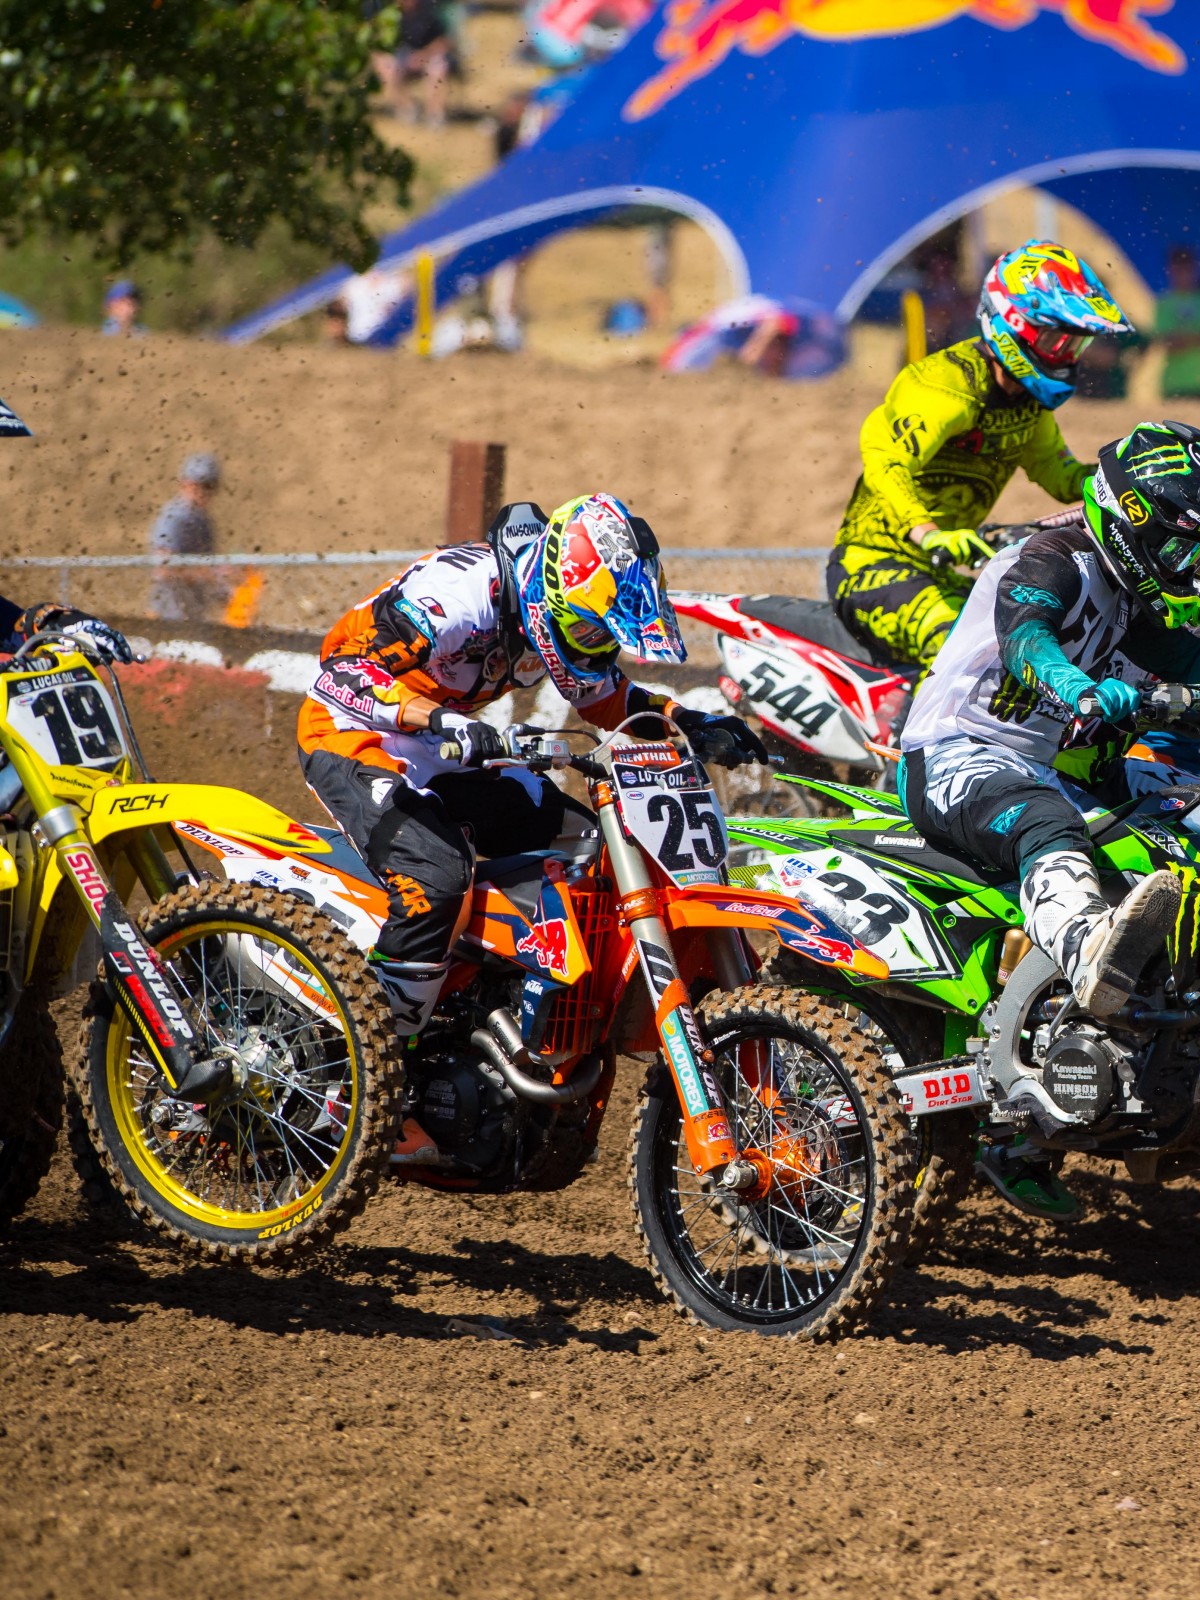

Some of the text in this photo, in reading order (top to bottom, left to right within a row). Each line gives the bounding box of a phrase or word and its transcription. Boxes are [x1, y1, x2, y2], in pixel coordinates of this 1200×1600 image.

[505, 522, 542, 538] MUSQUIN
[32, 672, 77, 690] LUCAS OIL
[740, 662, 838, 738] 544
[31, 683, 123, 766] 19
[618, 751, 676, 763] RENTHAL
[107, 792, 171, 816] RCH
[178, 824, 246, 857] DUNLOP
[647, 791, 728, 872] 25
[874, 834, 927, 849] Kawasaki
[112, 921, 194, 1040] DUNLOP
[524, 979, 544, 996] KTM
[680, 1004, 722, 1108] DUNOP
[1051, 1063, 1097, 1075] Kawasaki
[667, 1034, 704, 1112] MOTOREX
[922, 1073, 971, 1099] D.I.D
[1053, 1083, 1098, 1095] HINSON
[257, 1193, 324, 1240] DUNLOP
